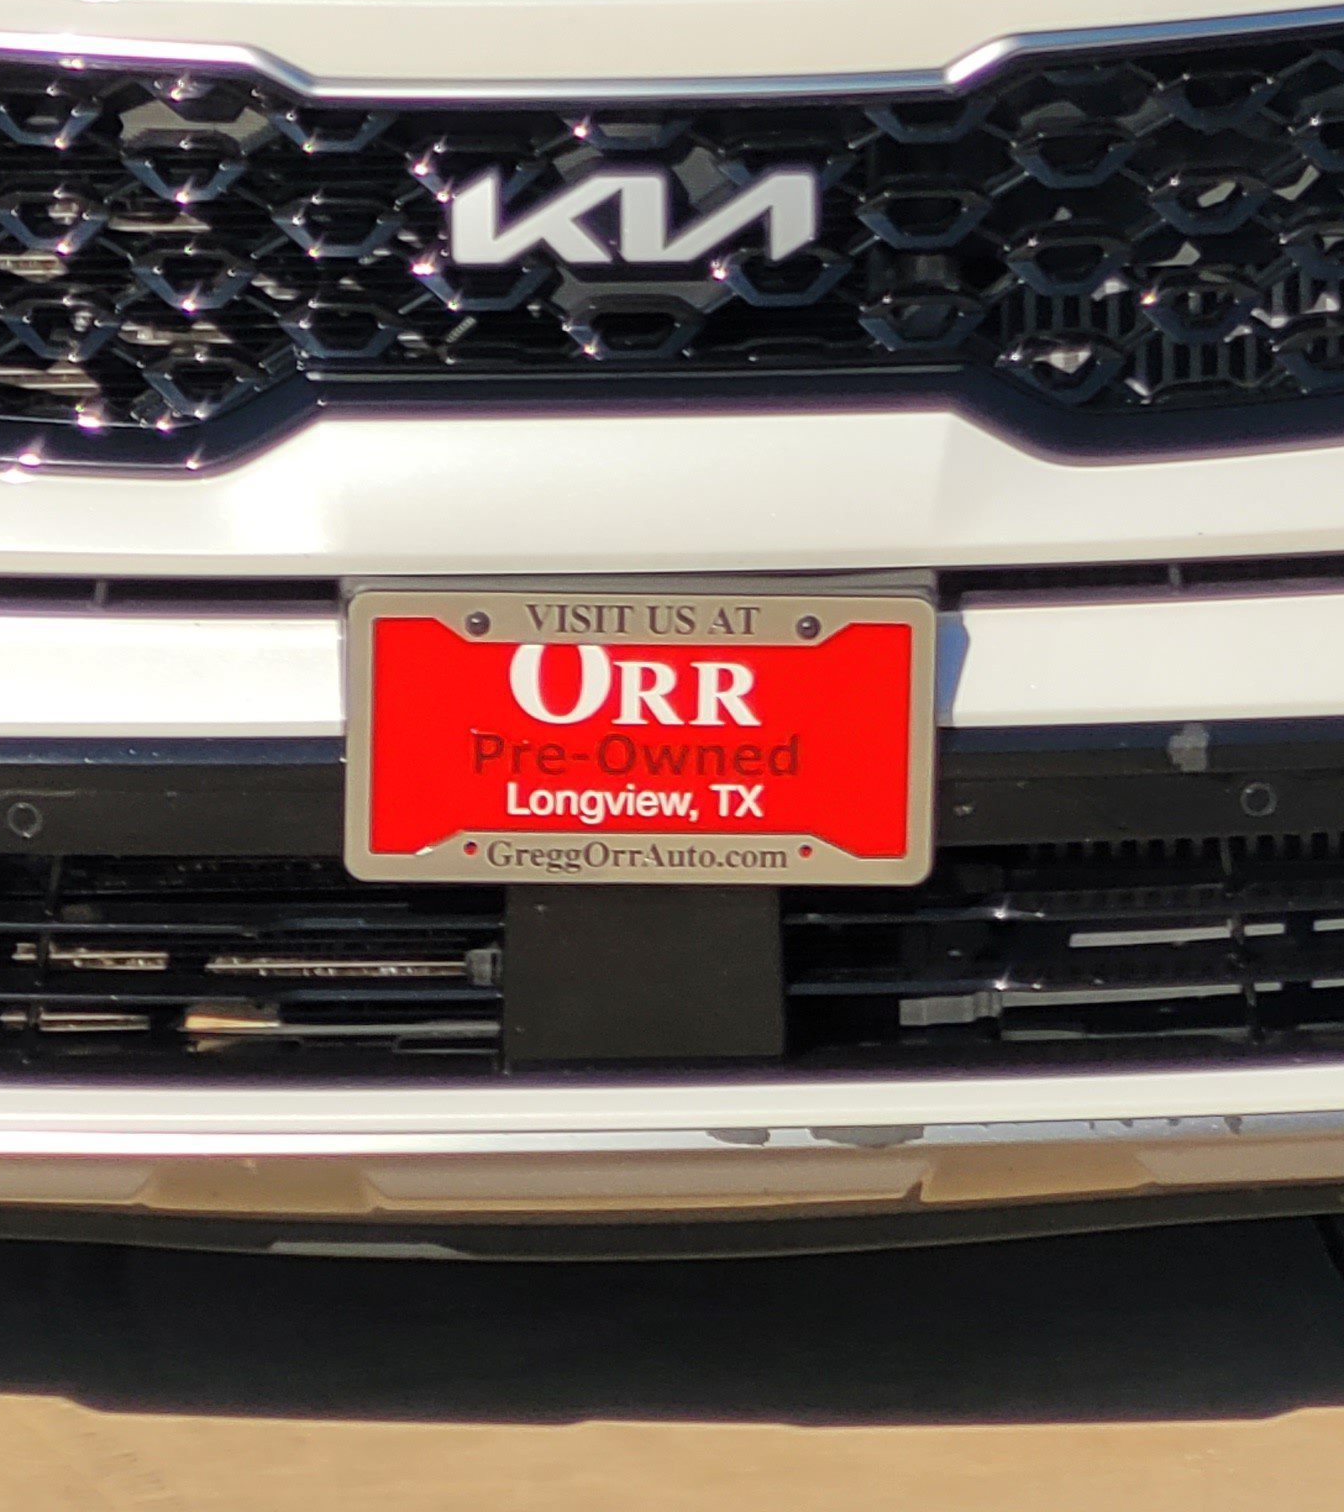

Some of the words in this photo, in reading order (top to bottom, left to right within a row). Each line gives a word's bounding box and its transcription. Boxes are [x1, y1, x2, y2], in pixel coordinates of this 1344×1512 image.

[452, 174, 816, 264] KIA
[526, 603, 635, 633] VISIT
[647, 605, 696, 634] US
[707, 606, 761, 635] AT
[471, 733, 802, 777] Pre-Owned
[506, 782, 698, 825] Longview,
[709, 783, 765, 818] TX
[486, 840, 789, 874] GreggOrrAuto.com
